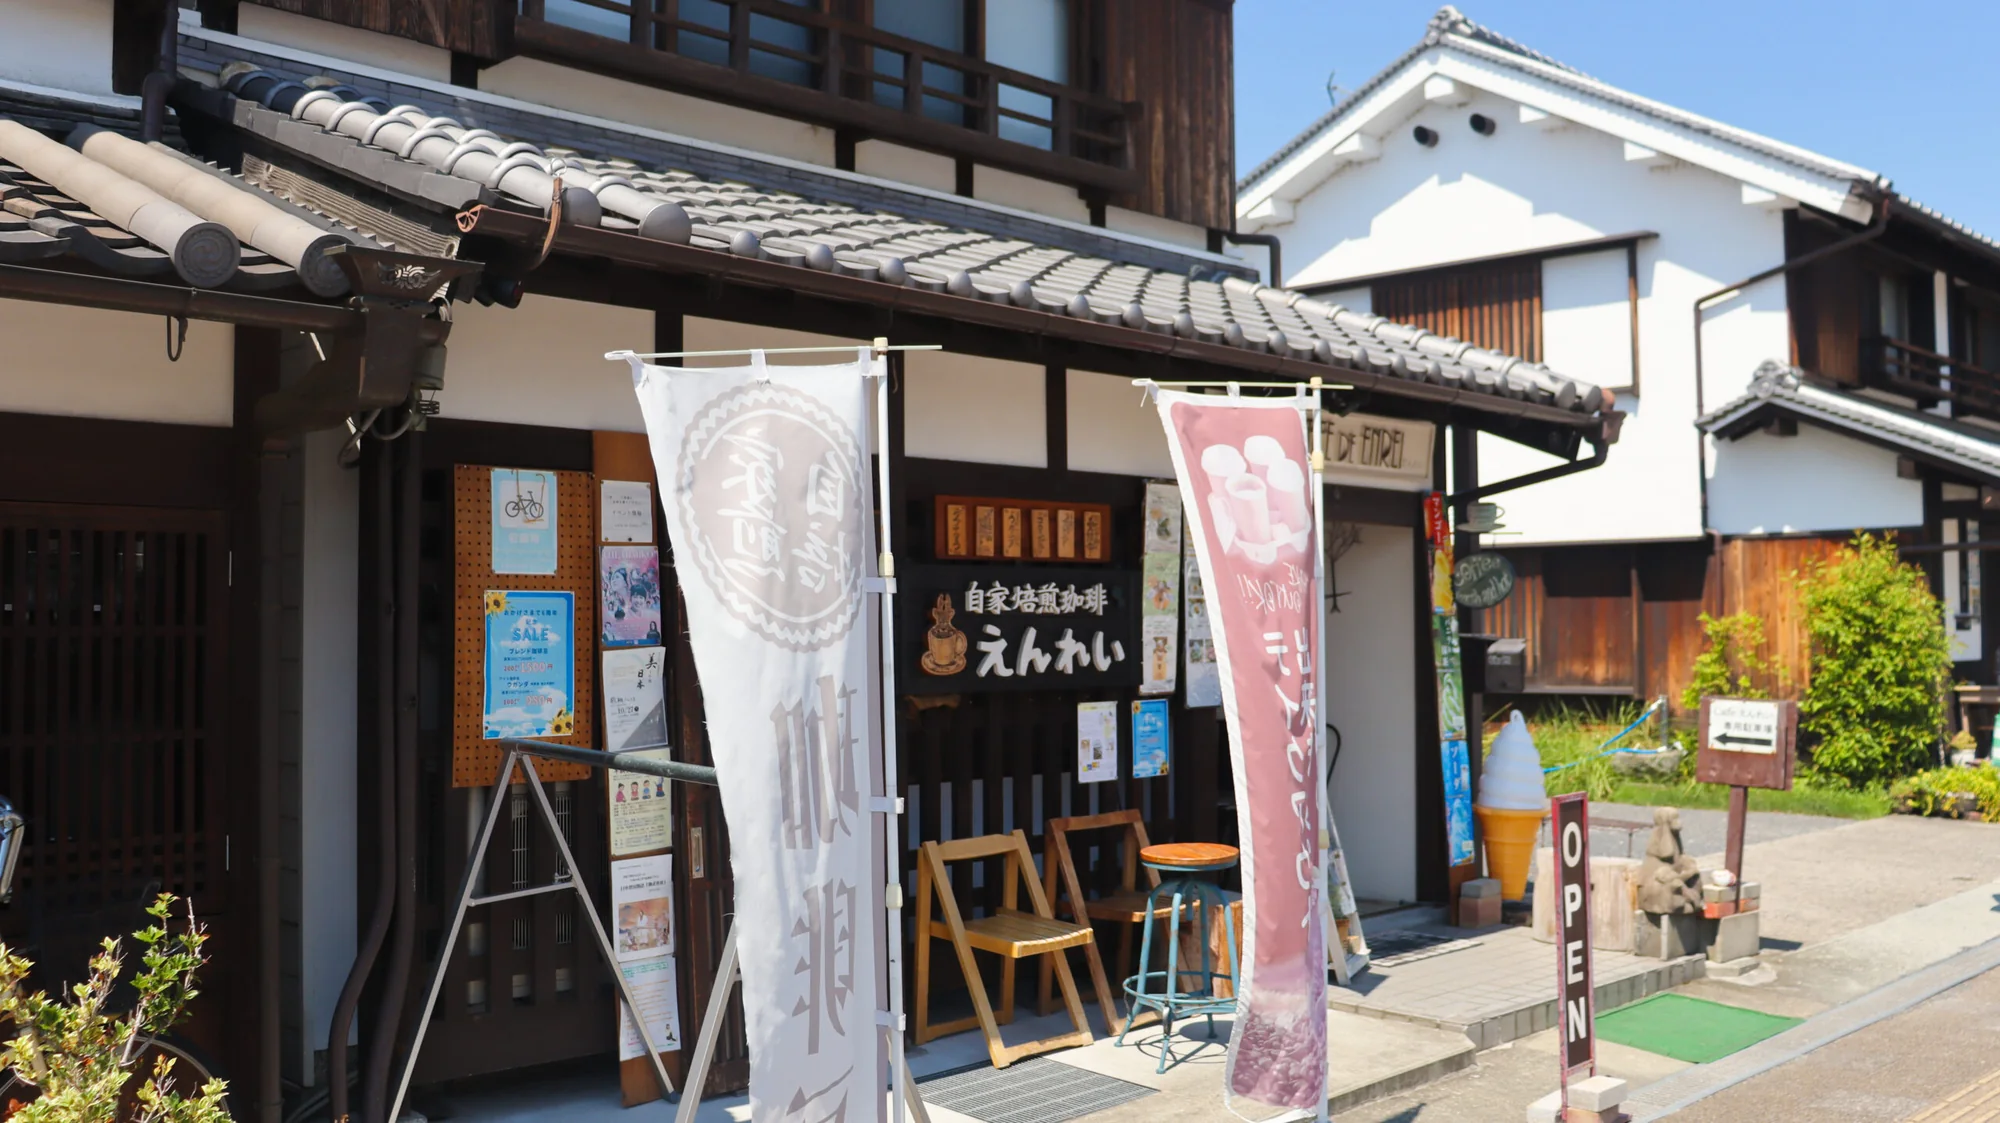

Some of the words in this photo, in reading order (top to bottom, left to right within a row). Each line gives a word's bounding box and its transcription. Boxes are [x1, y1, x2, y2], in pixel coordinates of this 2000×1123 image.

[1339, 431, 1356, 463] DE
[1362, 424, 1404, 469] ENREI
[1432, 497, 1441, 544] マンゴー
[965, 580, 1108, 616] 自家焙煎珈琲
[512, 627, 549, 641] SALE
[976, 624, 1125, 677] えんれい
[636, 669, 645, 689] 日本
[1724, 721, 1773, 733] 専用駐車場
[1450, 746, 1462, 790] ソーダ
[1562, 821, 1587, 1043] OPEN
